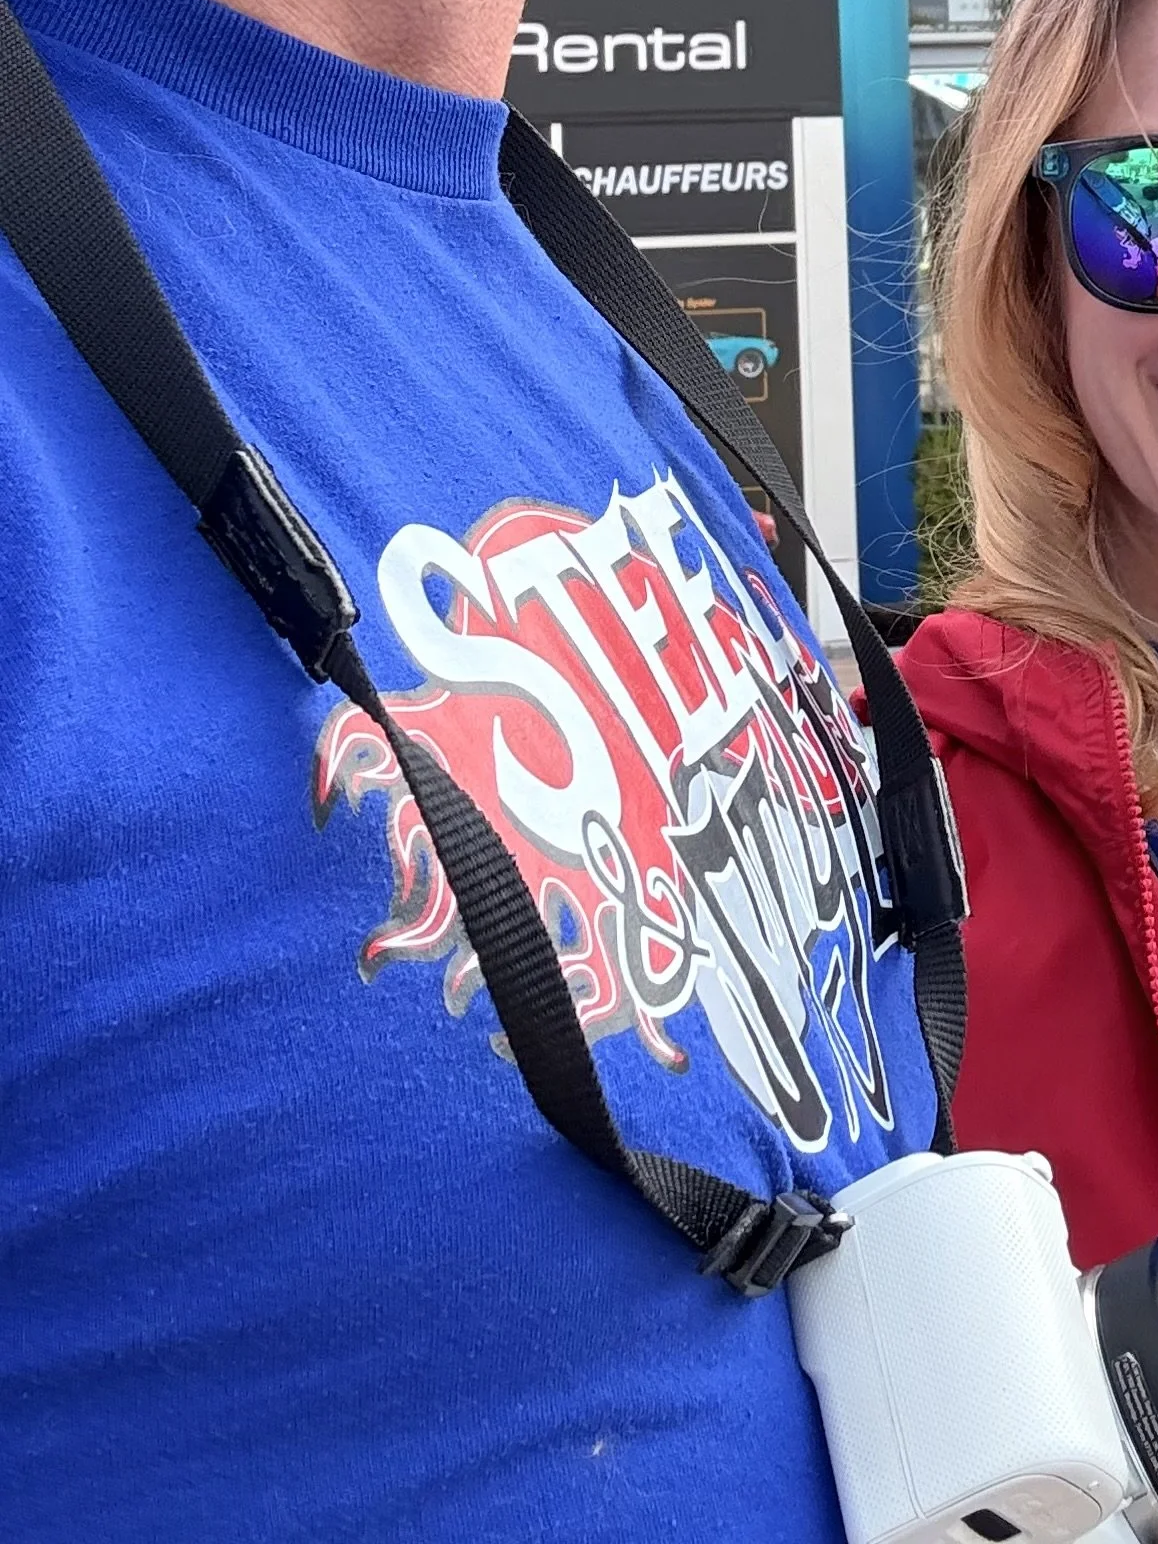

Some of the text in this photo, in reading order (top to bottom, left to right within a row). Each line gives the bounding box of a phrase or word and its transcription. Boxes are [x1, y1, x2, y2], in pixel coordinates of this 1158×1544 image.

[511, 20, 747, 73] Rental
[575, 161, 789, 197] CHAUFFEURS
[377, 463, 803, 848] STEEL
[582, 810, 718, 1018] &
